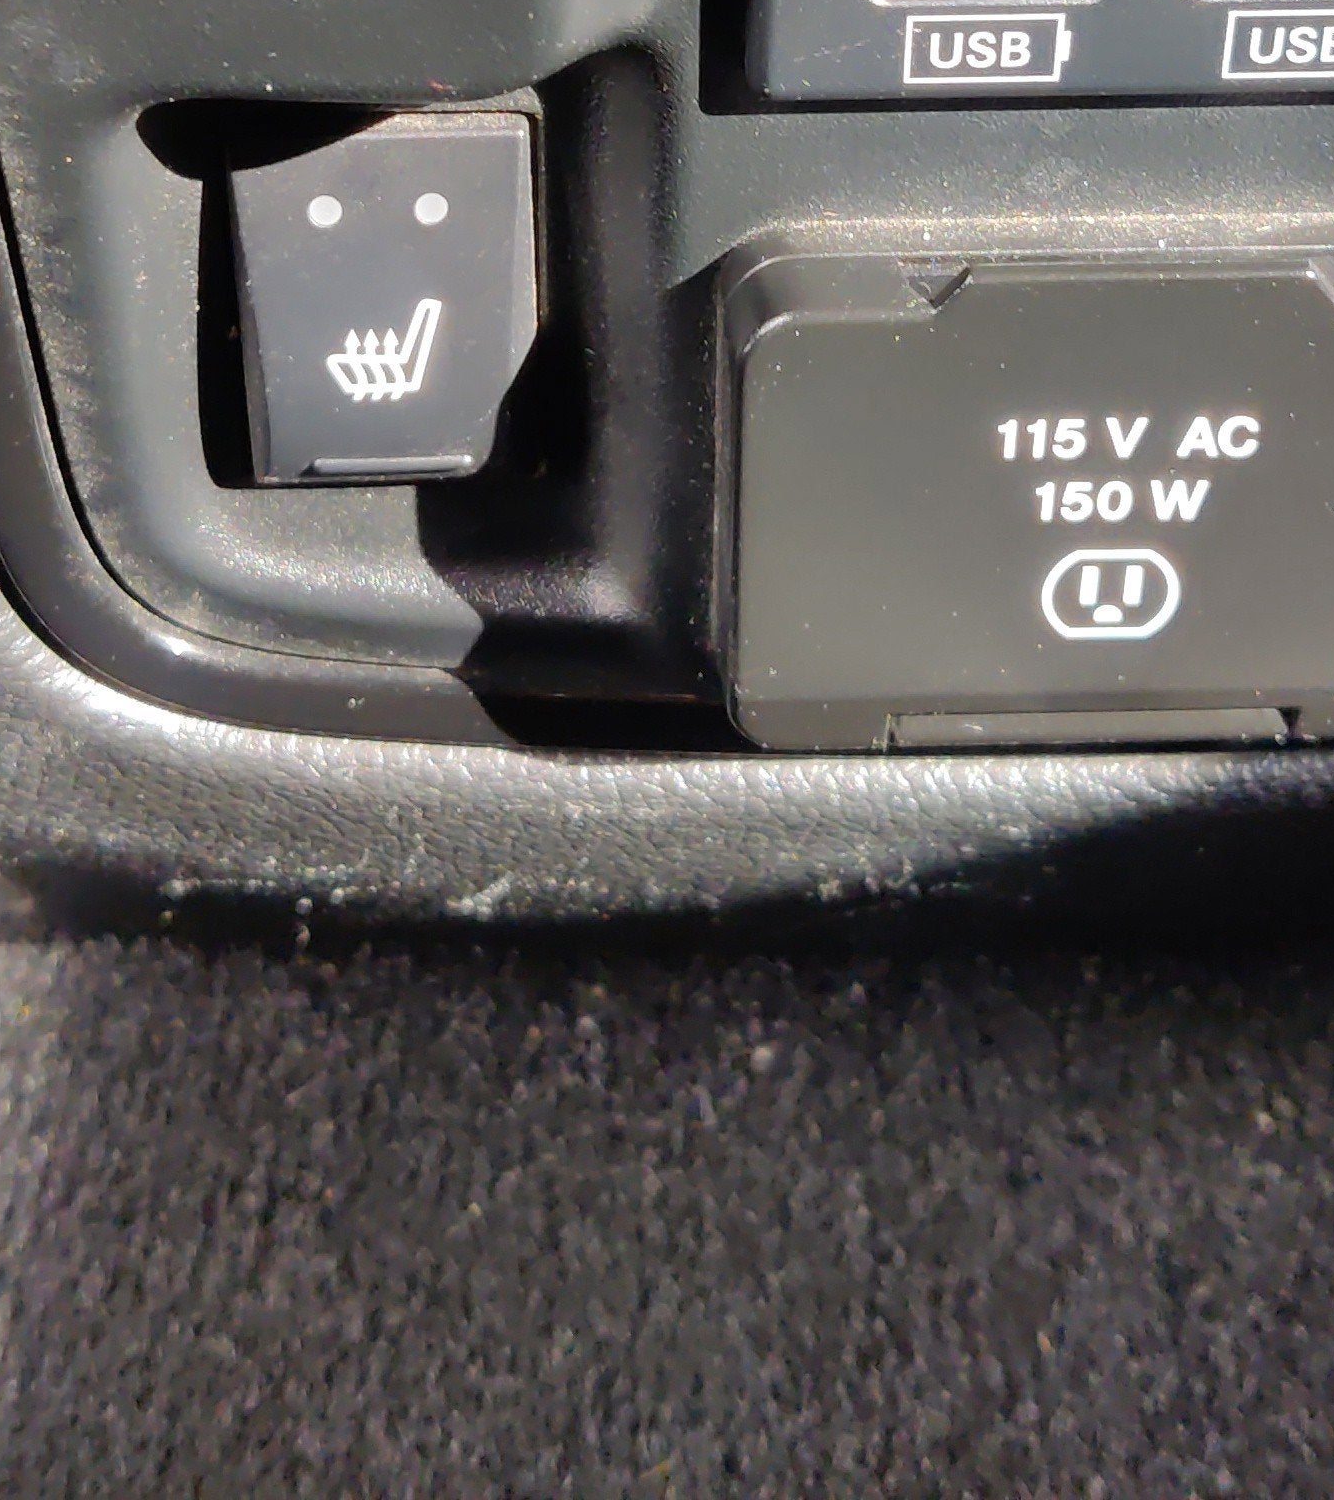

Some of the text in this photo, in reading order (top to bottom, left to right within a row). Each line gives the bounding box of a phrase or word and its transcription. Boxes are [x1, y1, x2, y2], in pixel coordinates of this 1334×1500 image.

[929, 30, 1032, 70] USB
[997, 414, 1262, 461] 115 V AC
[1034, 478, 1212, 523] 150 W
